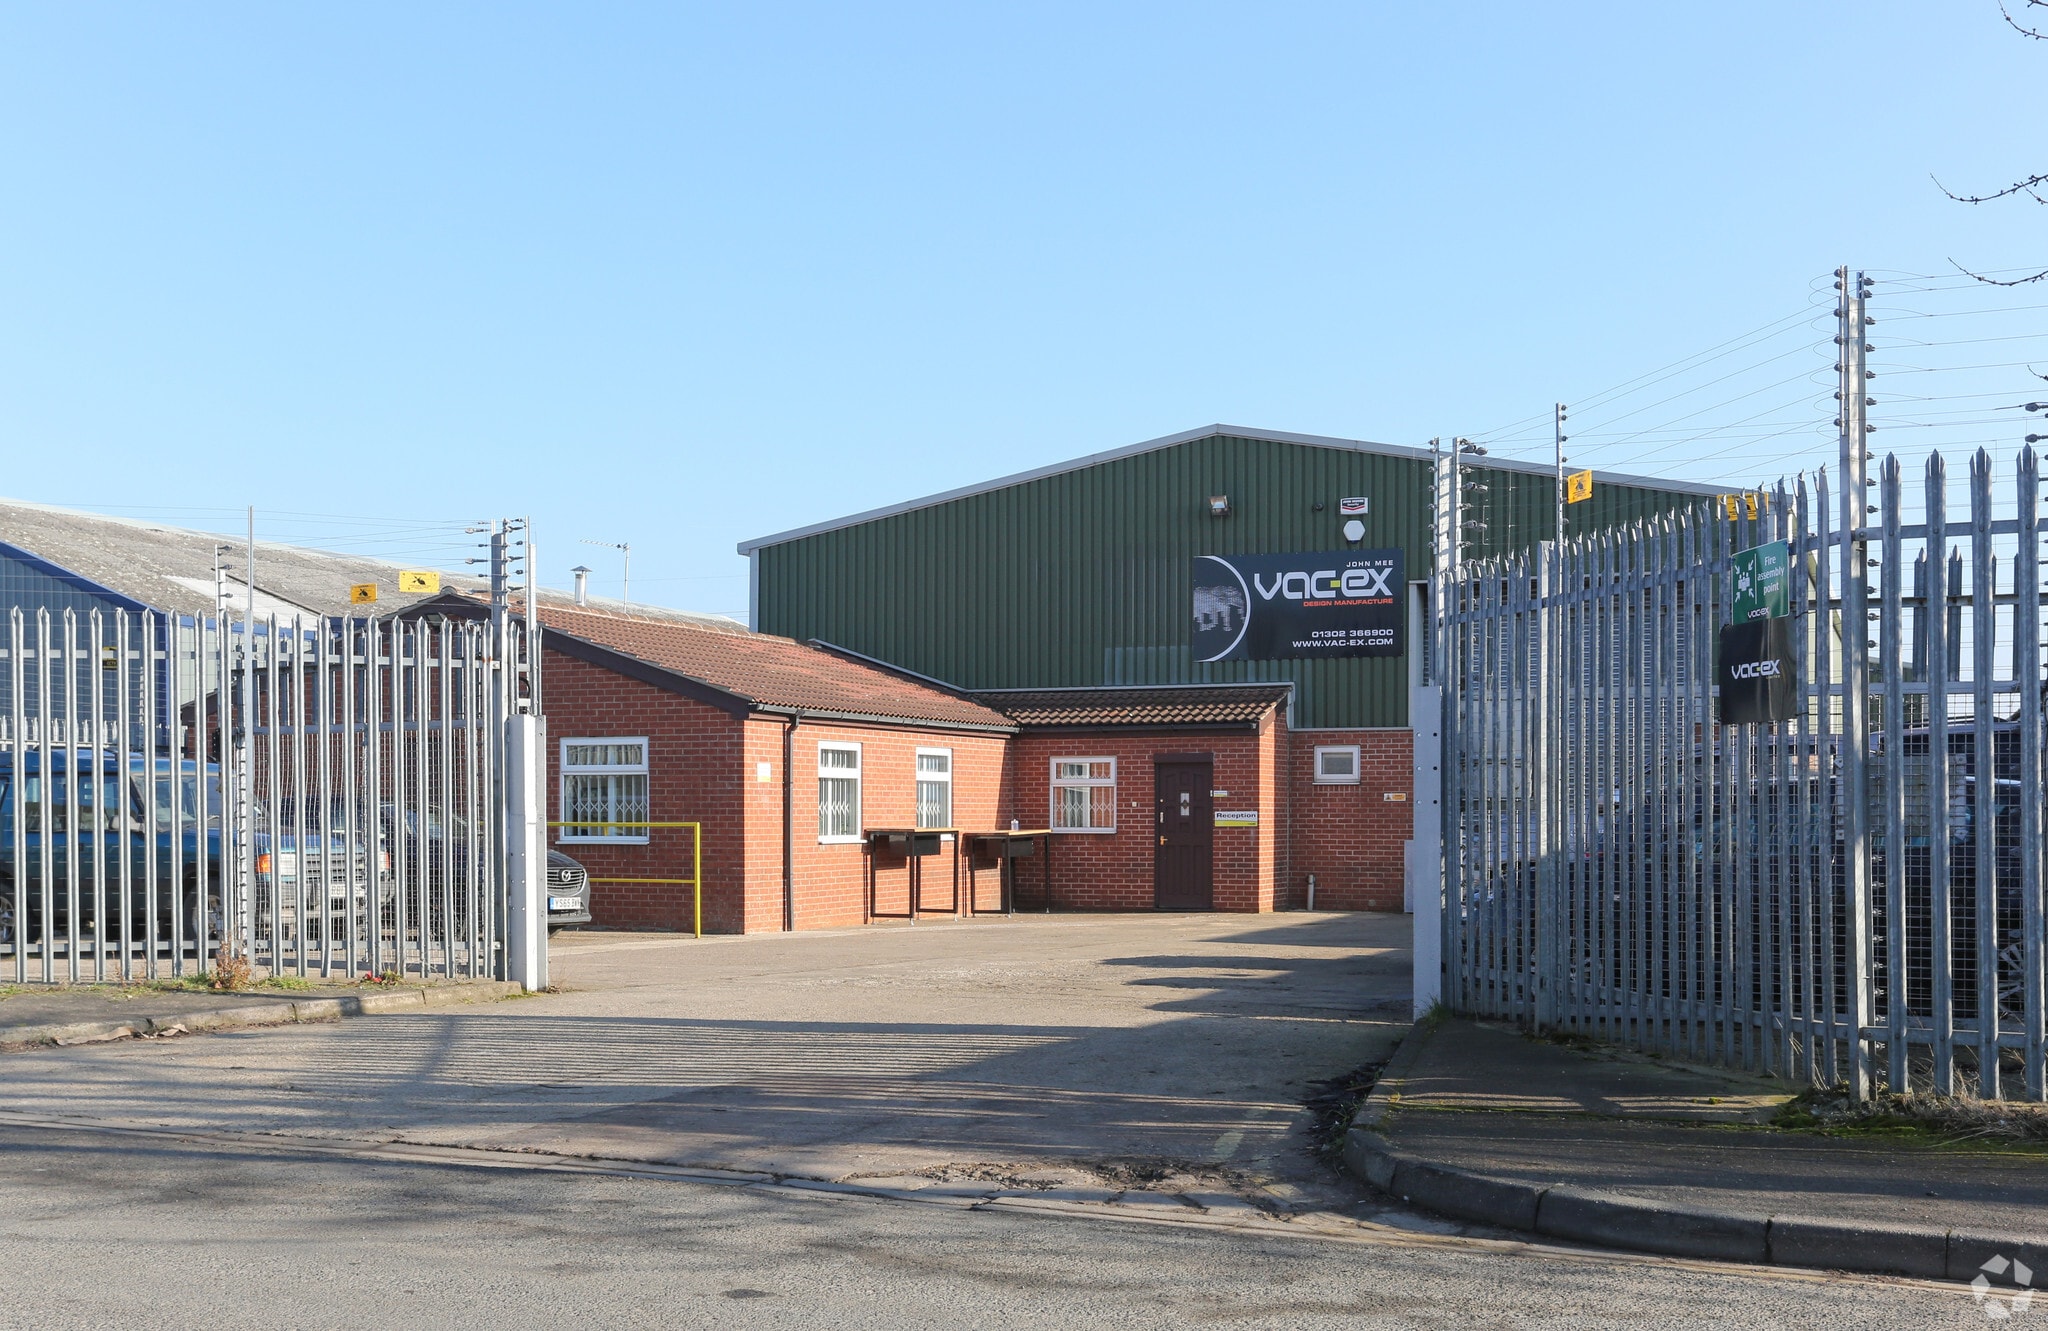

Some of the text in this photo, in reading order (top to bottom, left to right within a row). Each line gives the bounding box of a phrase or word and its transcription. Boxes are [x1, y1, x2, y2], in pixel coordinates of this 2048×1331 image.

[1764, 556, 1777, 566] Fire
[1757, 566, 1785, 581] assembly
[1763, 582, 1780, 596] point
[1334, 598, 1393, 606] MANUFACTURE
[1349, 629, 1394, 637] 366900
[1292, 638, 1393, 648] WWW.VAC-EX.COM
